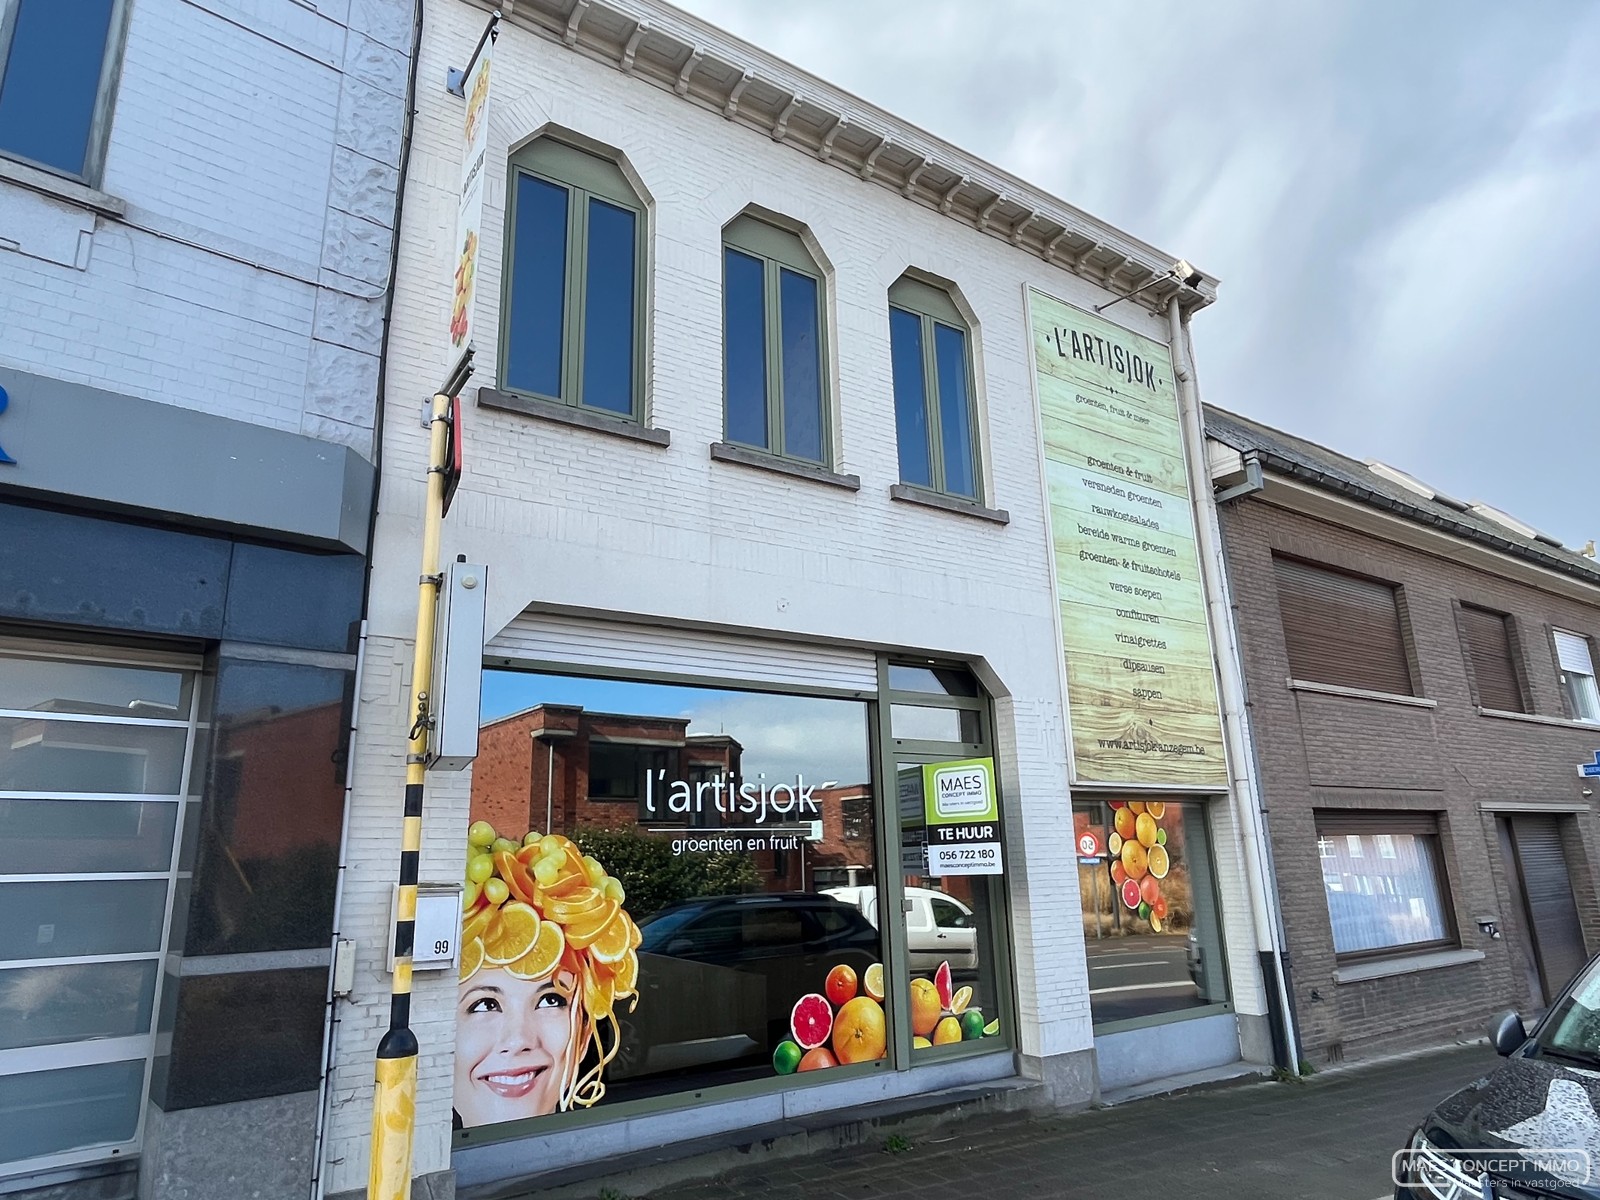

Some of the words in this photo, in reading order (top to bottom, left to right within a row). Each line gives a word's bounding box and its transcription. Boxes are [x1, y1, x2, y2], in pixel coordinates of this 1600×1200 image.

[1054, 327, 1156, 392] L'ARTISJOK
[1126, 410, 1132, 419] &
[1087, 456, 1125, 475] groenten
[1125, 466, 1133, 477] &
[1134, 469, 1154, 484] fruit
[1082, 478, 1126, 498] versneden
[1127, 491, 1163, 508] groenten
[1091, 504, 1160, 530] rauwkostsalades
[1077, 522, 1110, 540] bereide
[1110, 533, 1141, 548] warme
[1142, 541, 1177, 557] groenten
[1079, 550, 1120, 567] groenten-
[1122, 558, 1130, 569] &
[1131, 560, 1182, 581] fruitschotels
[1109, 581, 1133, 594] verse
[1134, 586, 1163, 601] soepen
[1115, 608, 1161, 624] confituren
[1114, 632, 1167, 650] vinaigrettes
[1123, 658, 1165, 674] dipsausen
[1132, 687, 1163, 700] sappen
[941, 775, 982, 792] MAES
[646, 769, 818, 823] l'artisjok
[942, 791, 965, 799] CONCEPT
[937, 828, 954, 840] TE
[956, 826, 993, 839] HUUR
[671, 836, 743, 856] groenten
[747, 839, 766, 850] en
[769, 834, 799, 850] fruit
[939, 851, 957, 861] 056
[960, 850, 976, 860] 722
[978, 849, 995, 858] 180
[434, 940, 449, 954] 99
